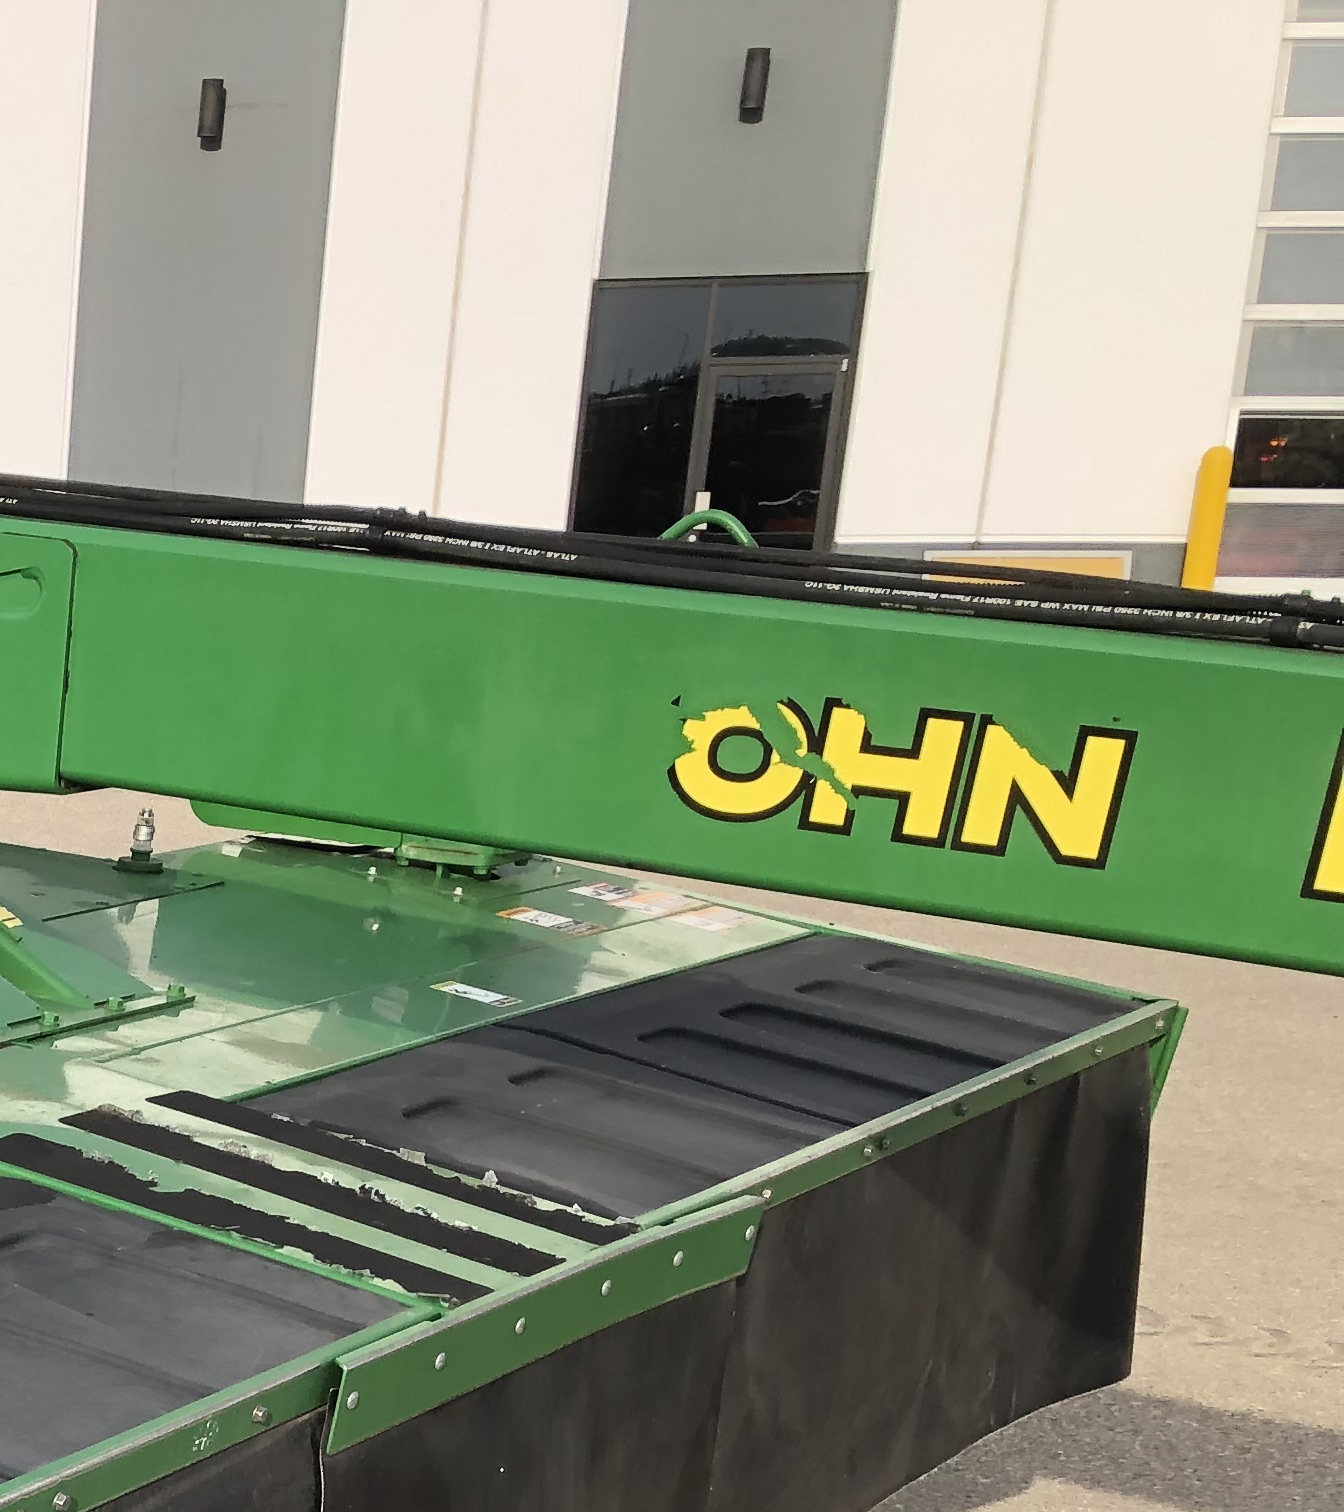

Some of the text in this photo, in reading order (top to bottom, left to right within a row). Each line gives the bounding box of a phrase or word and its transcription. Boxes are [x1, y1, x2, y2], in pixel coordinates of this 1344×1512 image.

[545, 550, 578, 561] ATLAS
[891, 587, 938, 599] Resistant
[939, 592, 971, 602] Flame
[974, 594, 1011, 605] 100R17
[1013, 598, 1039, 608] SAE
[1040, 600, 1060, 609] WP
[1062, 601, 1089, 611] MAX
[1092, 604, 1112, 613] PSI
[1113, 605, 1141, 615] 3250
[1142, 607, 1173, 617] INCH
[1202, 612, 1265, 624] ATLAFLEX
